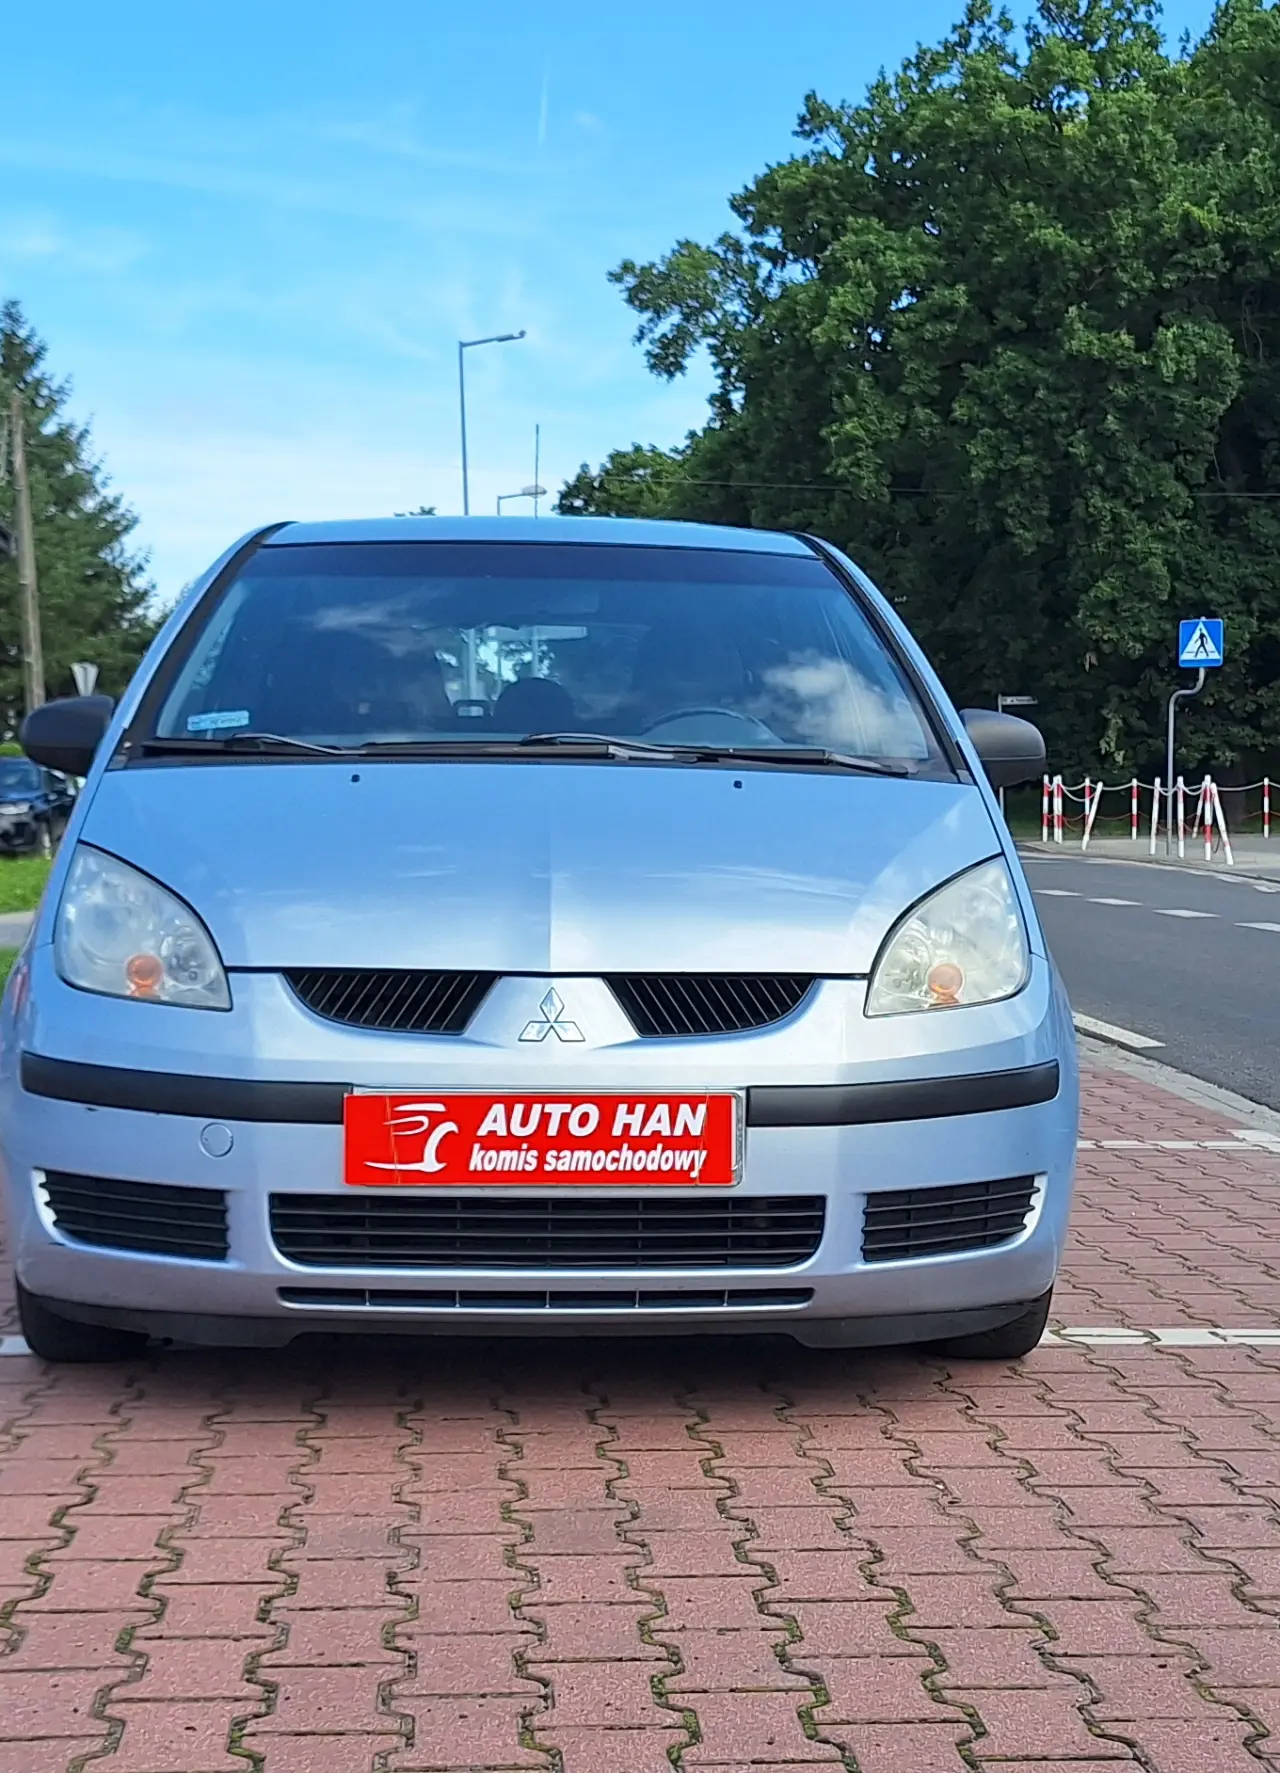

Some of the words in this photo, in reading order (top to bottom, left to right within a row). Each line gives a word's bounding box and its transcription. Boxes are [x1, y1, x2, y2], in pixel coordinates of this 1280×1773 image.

[476, 1103, 600, 1137] AUTO
[611, 1103, 707, 1137] HAN
[469, 1144, 539, 1172] komis
[543, 1143, 707, 1178] samochodowy
